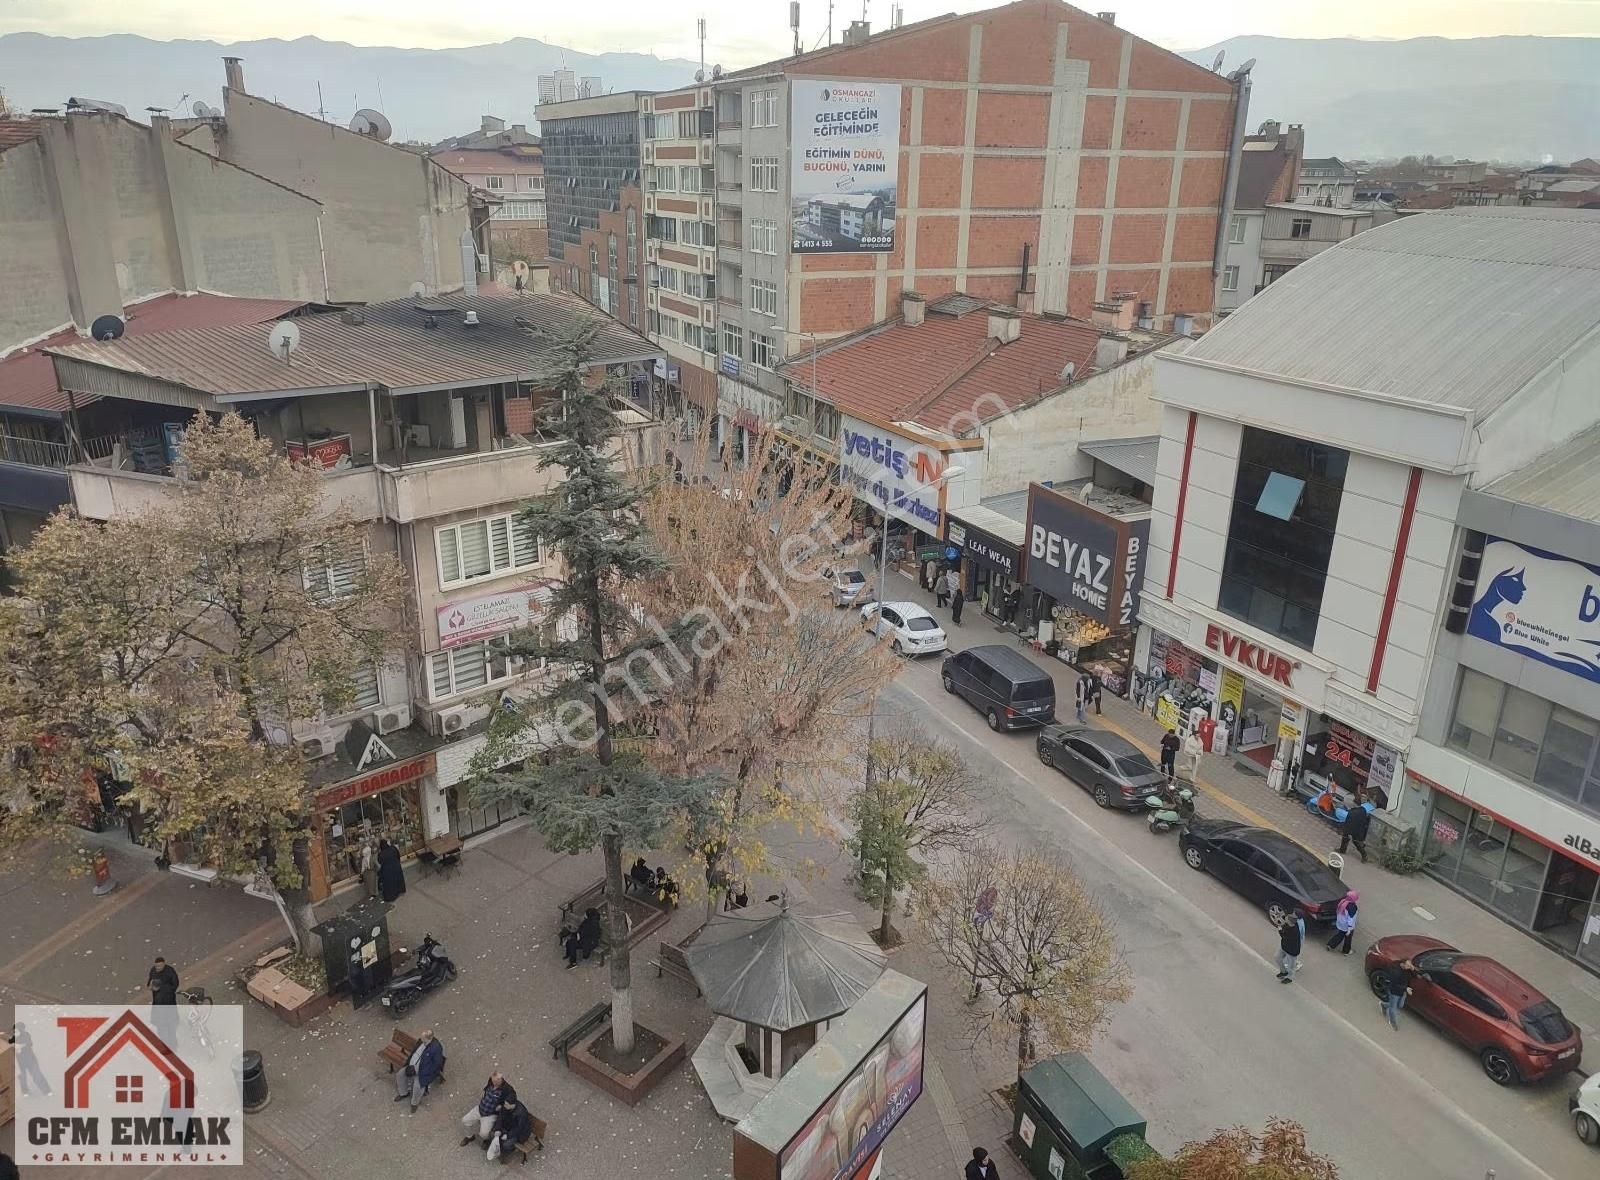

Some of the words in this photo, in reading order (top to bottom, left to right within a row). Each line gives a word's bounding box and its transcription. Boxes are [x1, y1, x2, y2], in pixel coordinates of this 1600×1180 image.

[816, 107, 878, 123] GELECEĞİN
[814, 122, 879, 137] EĞİTİMİNDE
[805, 147, 850, 159] EĞİTİMİN
[852, 163, 886, 173] YARINI
[969, 539, 987, 555] LEAF
[988, 548, 1012, 569] WEAR
[1030, 524, 1111, 593] BEYAZ
[1119, 537, 1140, 624] BEYAZ
[1071, 582, 1107, 611] HOME
[1530, 635, 1550, 647] White
[1205, 623, 1295, 689] EVKUR
[1325, 741, 1352, 768] 24
